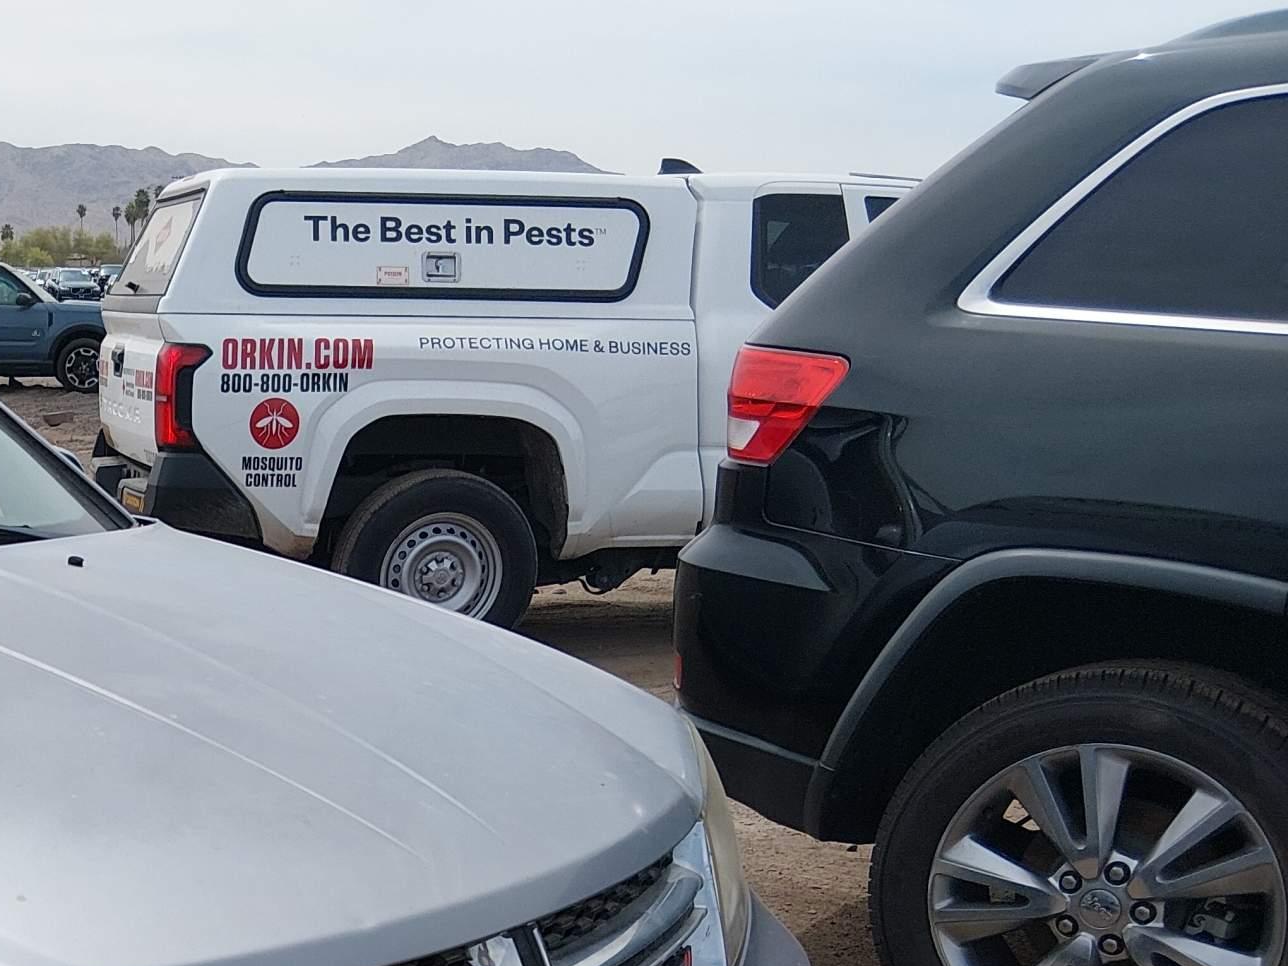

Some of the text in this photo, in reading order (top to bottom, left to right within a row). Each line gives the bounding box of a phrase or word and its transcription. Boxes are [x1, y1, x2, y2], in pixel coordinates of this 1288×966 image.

[304, 215, 370, 242] The
[380, 216, 457, 244] Best
[465, 218, 494, 245] in
[222, 338, 374, 370] ORKIN.COM
[419, 337, 691, 356] PROTECTING HOME & BUSINESS
[220, 373, 349, 393] 800-800-ORKIN
[241, 456, 303, 472] MOSQUITO
[245, 473, 297, 488] CONTROL
